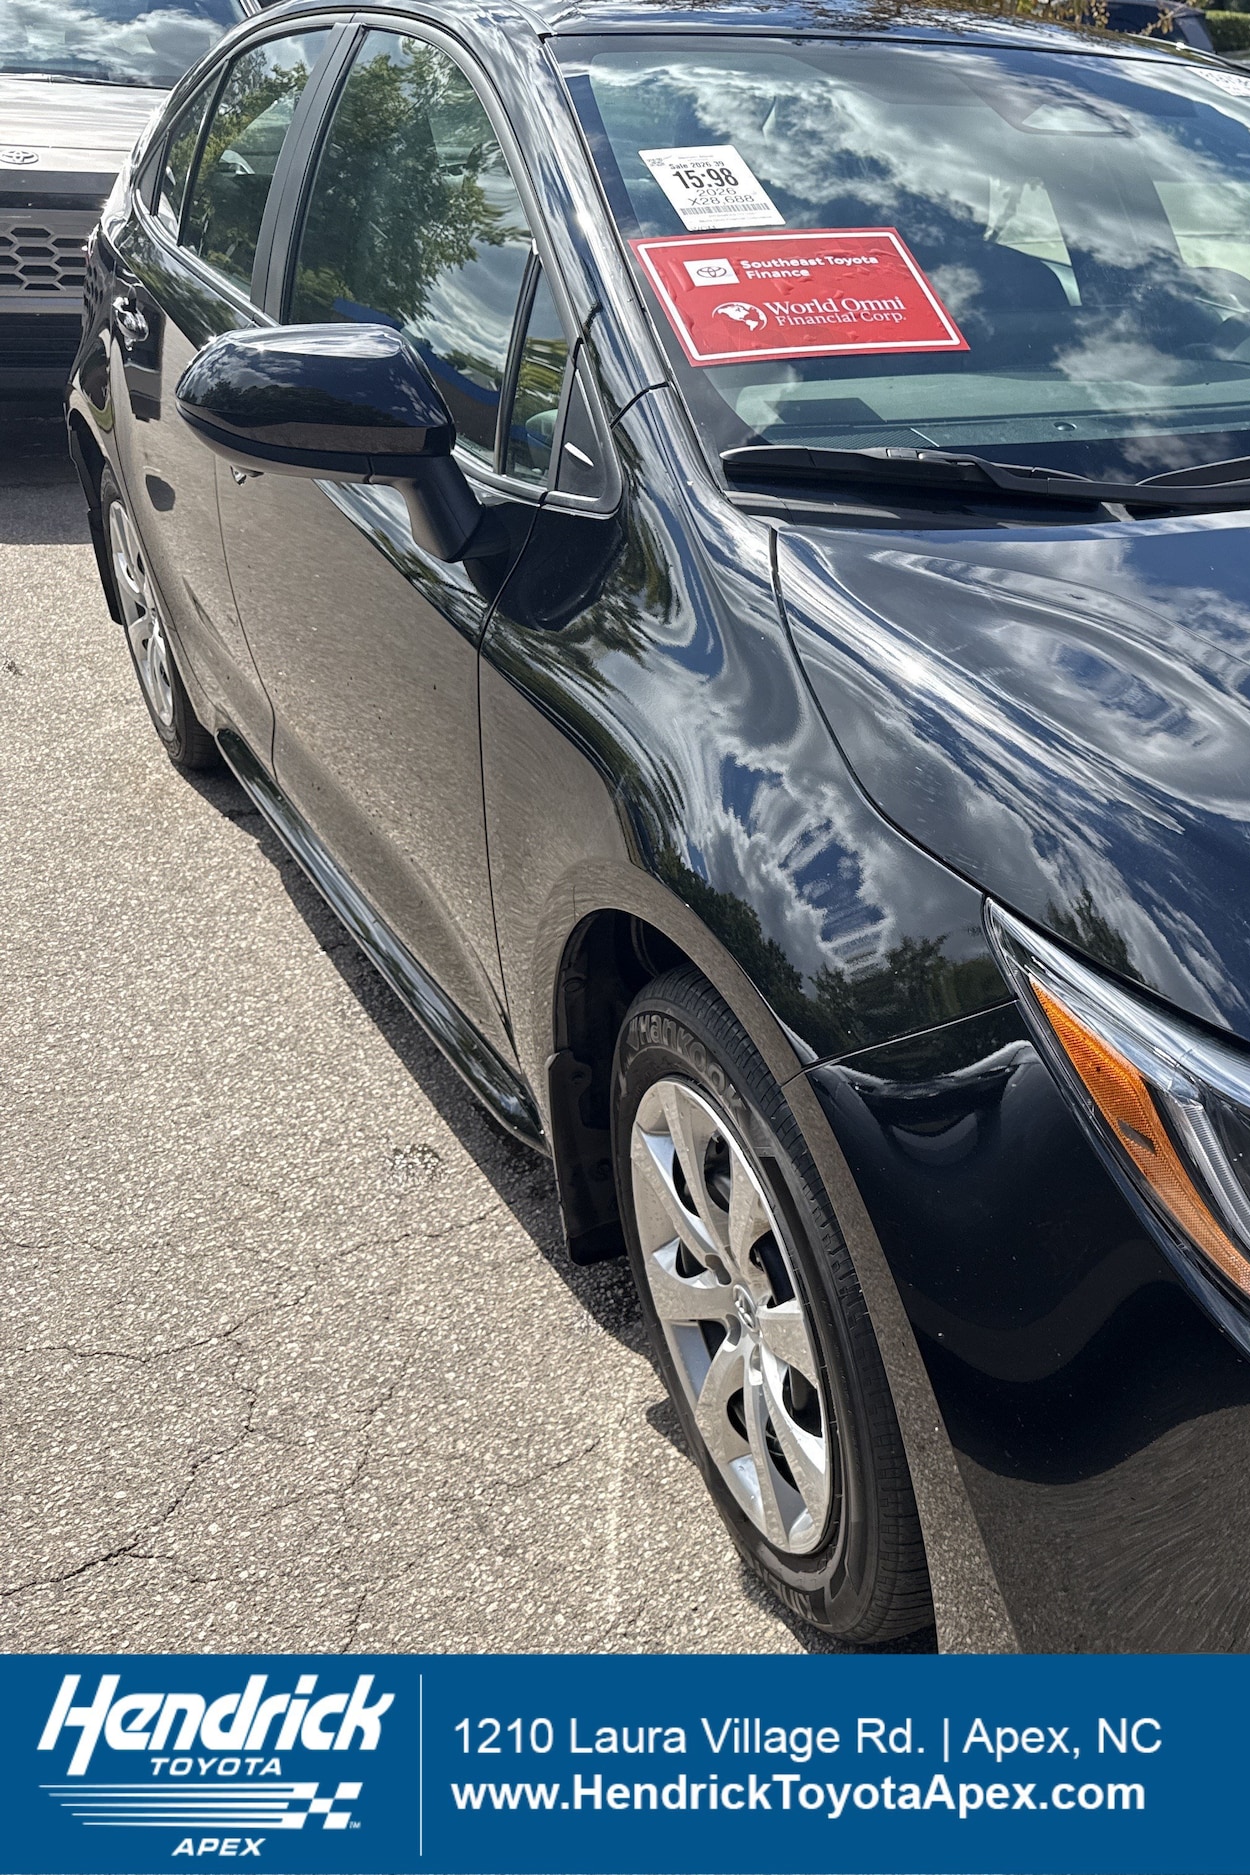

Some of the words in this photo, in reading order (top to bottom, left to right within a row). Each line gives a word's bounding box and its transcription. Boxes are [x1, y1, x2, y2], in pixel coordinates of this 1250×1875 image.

[669, 162, 689, 170] Sale
[690, 161, 712, 169] 2026
[672, 167, 739, 189] 15:98
[696, 187, 737, 197] 2026
[688, 195, 755, 206] X28,688
[740, 256, 824, 269] Southeast
[825, 255, 879, 267] Toyota
[745, 268, 811, 280] Finance
[764, 297, 840, 315] World
[841, 296, 906, 312] Omni
[775, 311, 858, 326] Financial
[860, 310, 907, 324] Corp.
